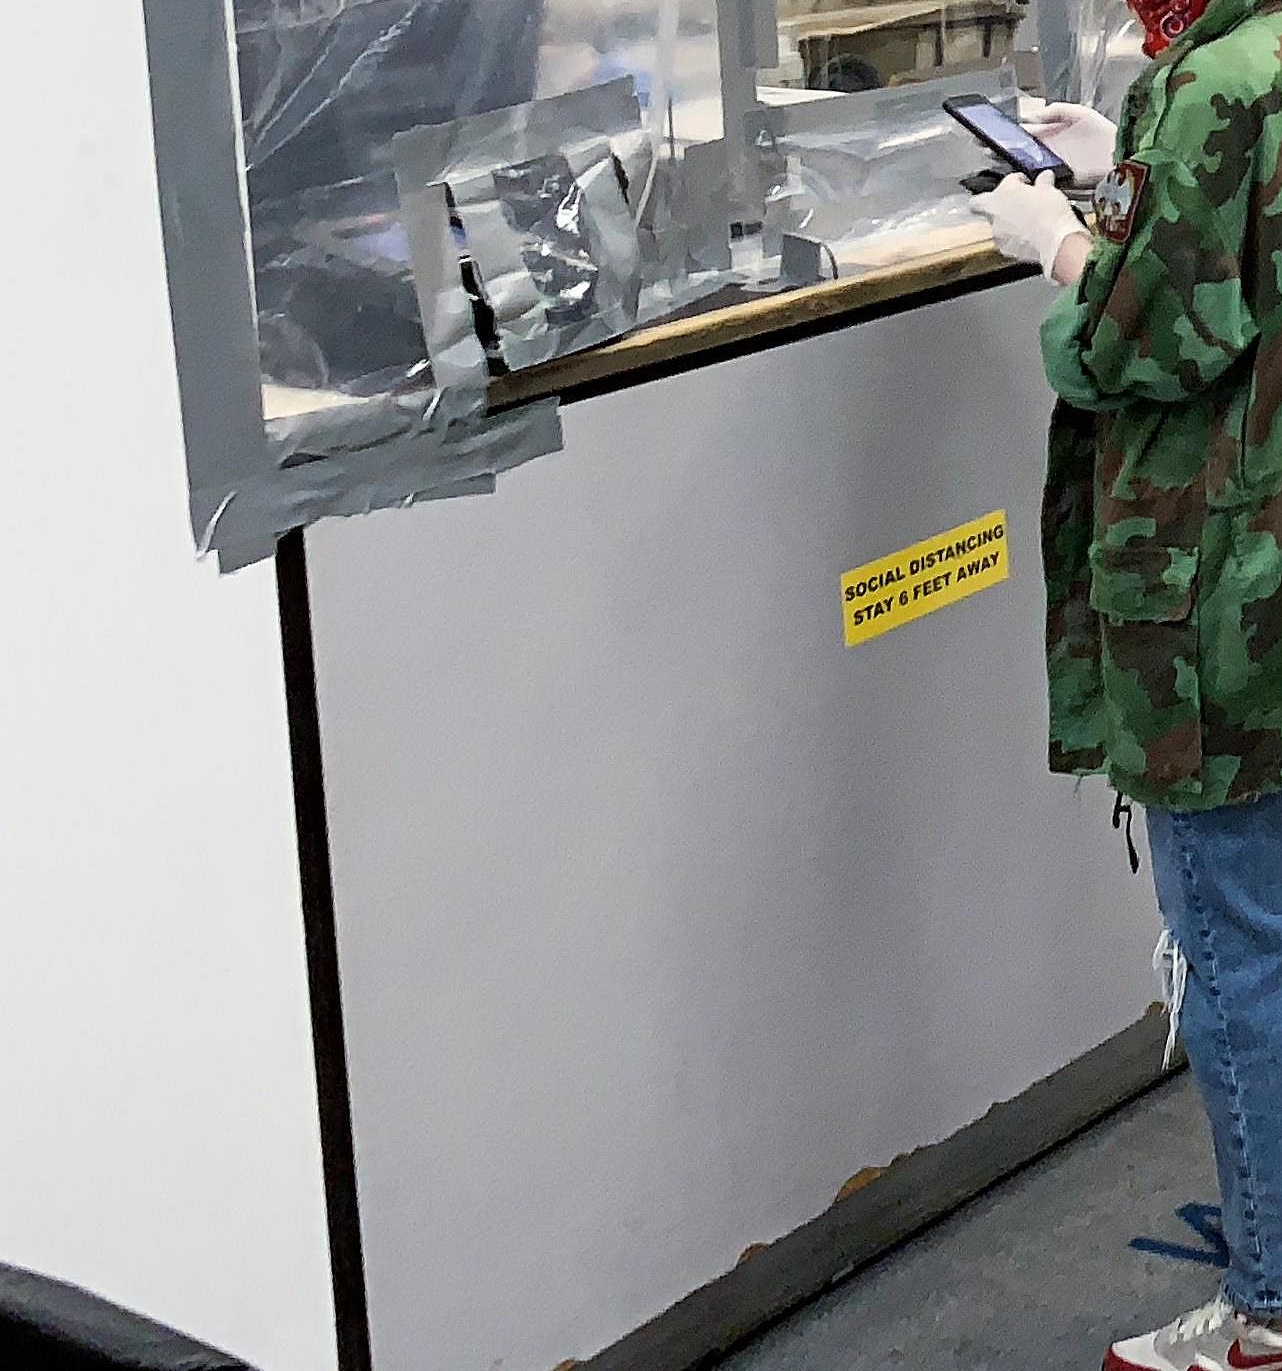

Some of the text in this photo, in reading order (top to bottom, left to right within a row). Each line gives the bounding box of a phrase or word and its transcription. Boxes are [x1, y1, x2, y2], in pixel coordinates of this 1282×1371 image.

[844, 524, 1004, 602] SOCIAL DISTANCING
[853, 551, 1000, 626] STAY 6 FEET AWAY
